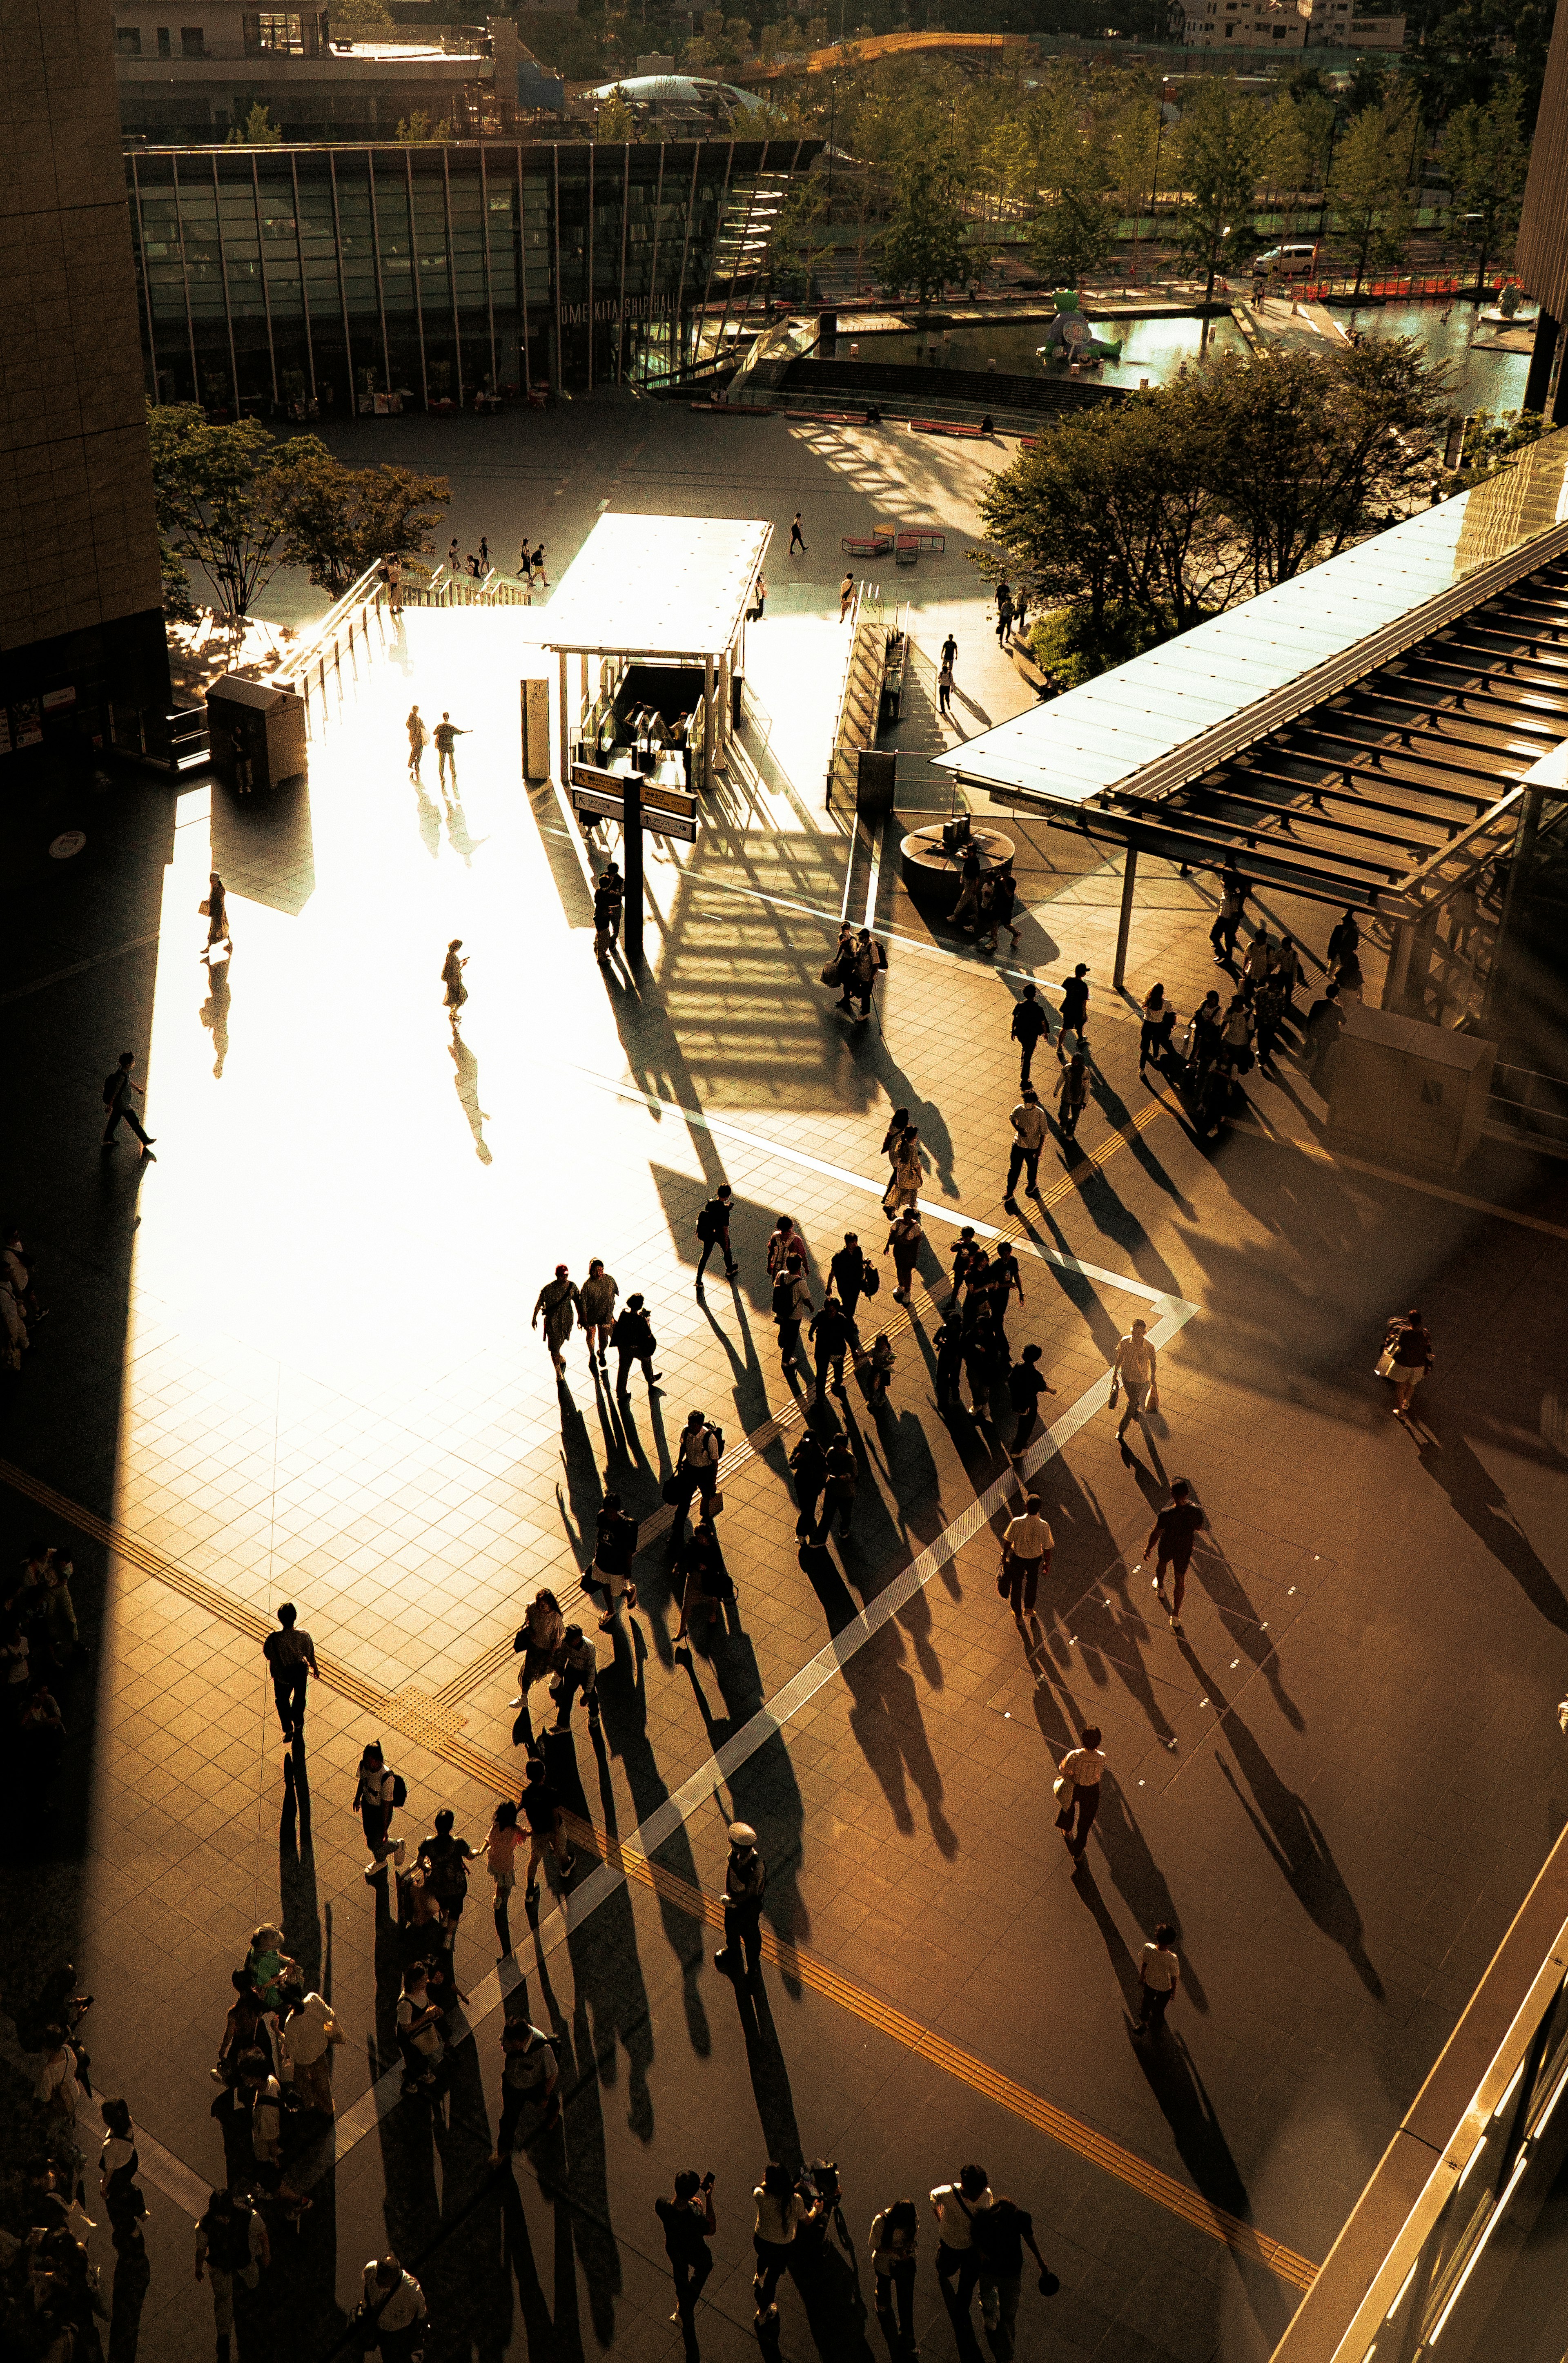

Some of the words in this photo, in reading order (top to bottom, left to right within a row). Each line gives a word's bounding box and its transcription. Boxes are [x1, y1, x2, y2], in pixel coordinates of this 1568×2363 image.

[561, 303, 588, 325] UME
[594, 299, 618, 321] KITA
[624, 295, 648, 318] SHIP
